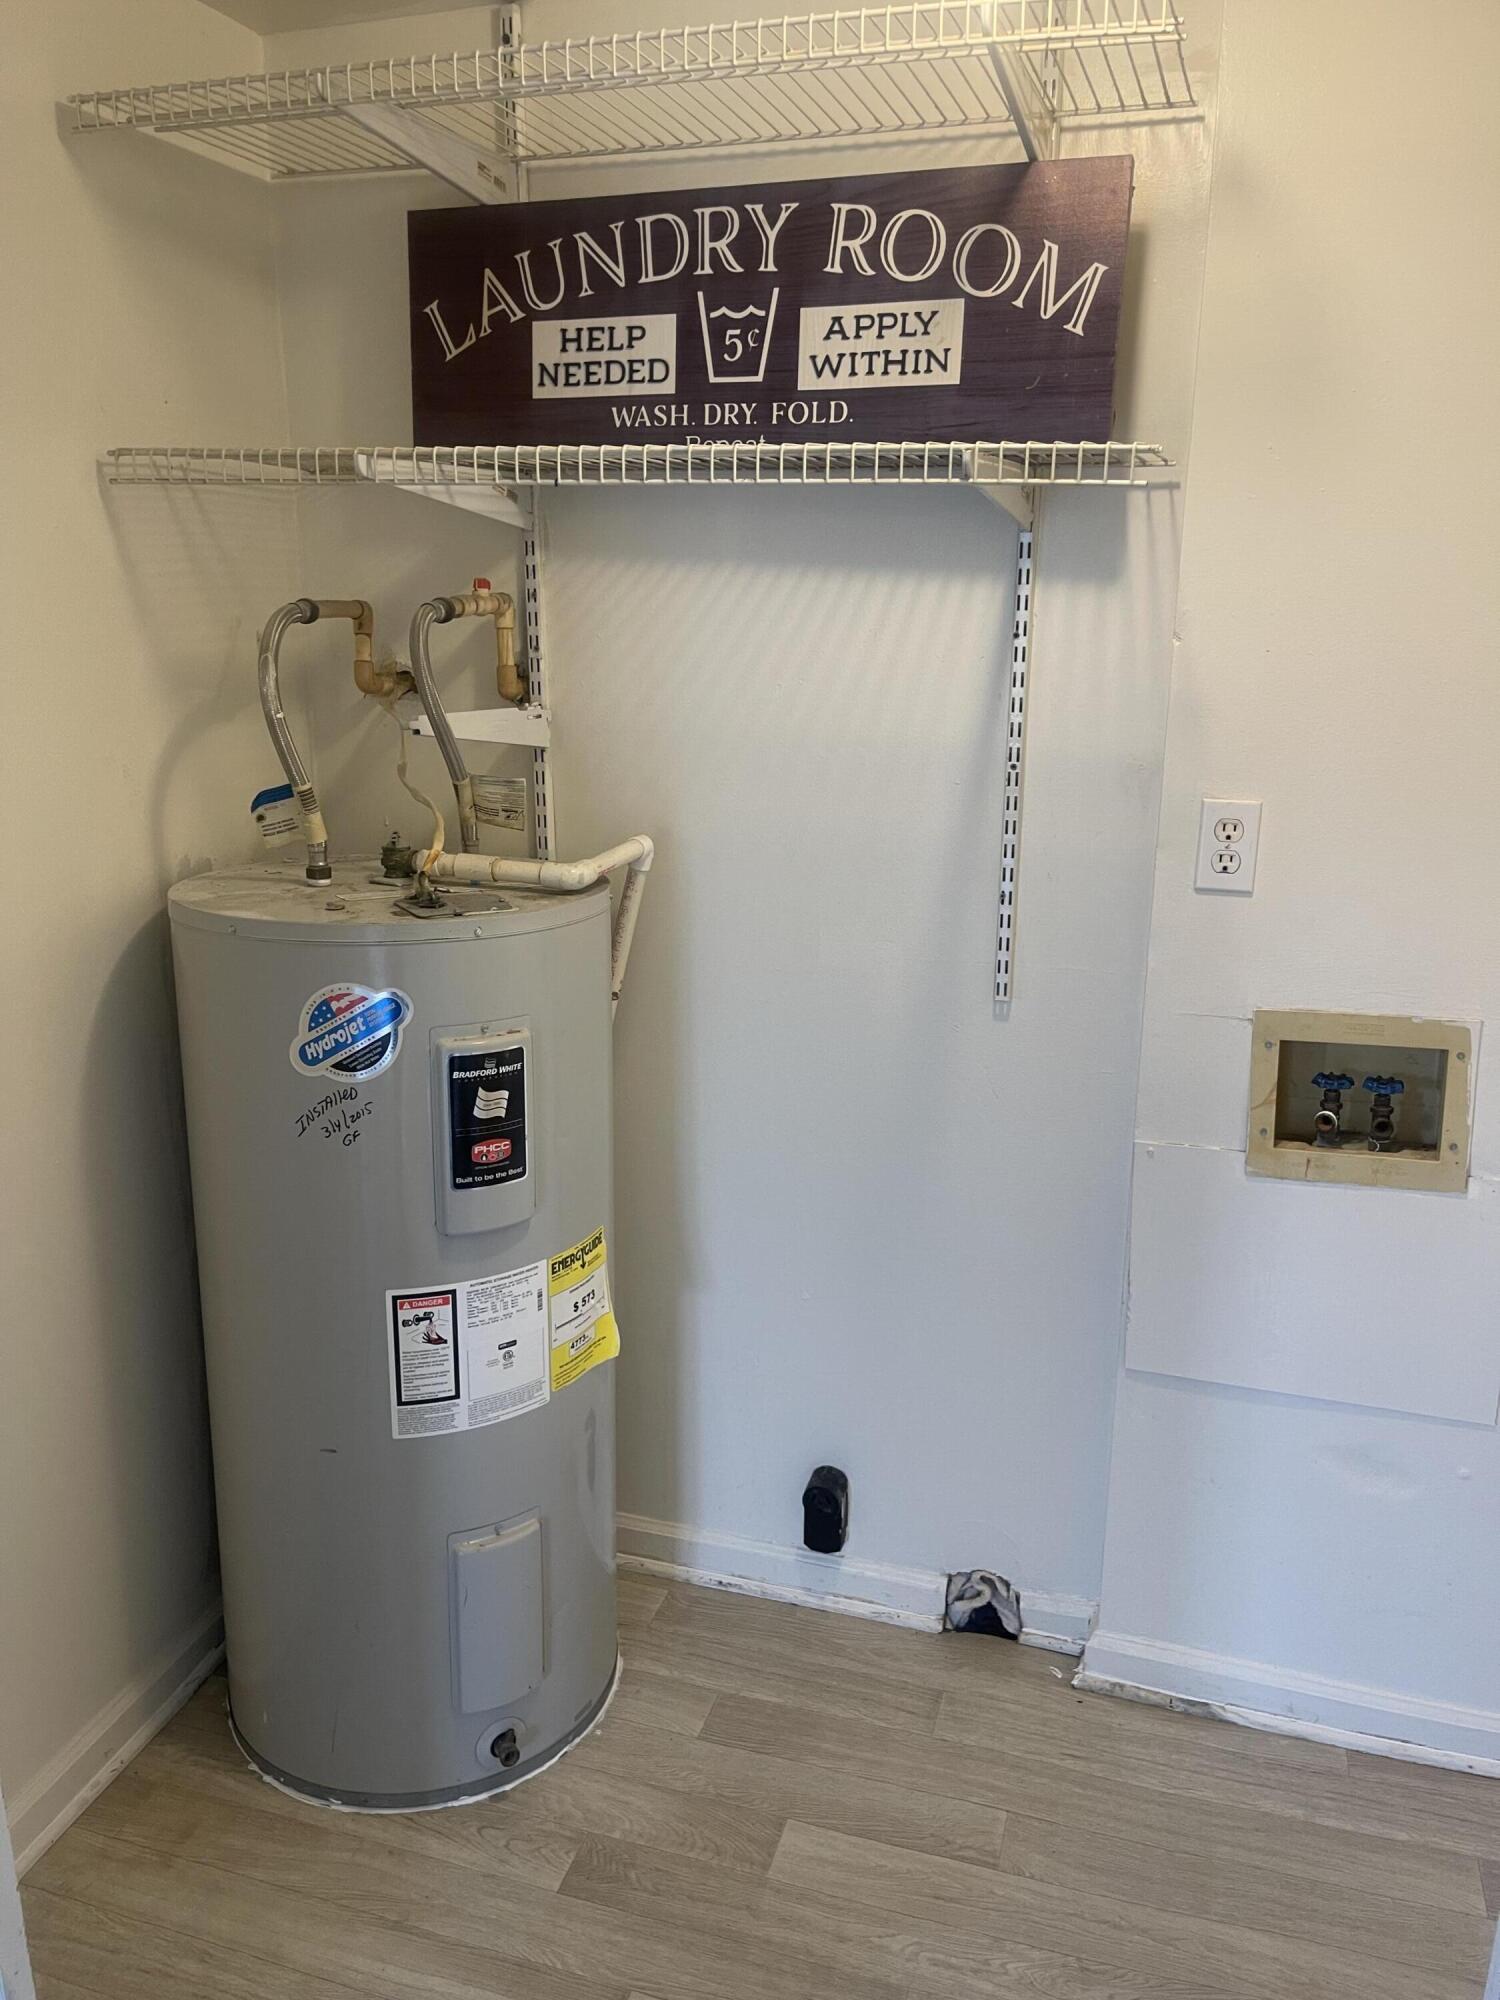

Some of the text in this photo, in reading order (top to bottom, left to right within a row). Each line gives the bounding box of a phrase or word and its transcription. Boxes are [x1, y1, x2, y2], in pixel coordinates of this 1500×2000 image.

[422, 202, 1109, 361] LAUNDRY ROOM
[559, 325, 647, 353] HELP
[822, 310, 940, 341] APPLY
[723, 328, 760, 362] 5¢
[537, 358, 670, 387] NEEDED
[808, 347, 953, 380] WITHIN
[611, 400, 854, 428] WASH. DRY. FOLD.
[304, 1016, 367, 1060] Hydrojet
[452, 1068, 498, 1079] BRADFORD
[498, 1062, 523, 1074] WHITE
[474, 1141, 511, 1154] PHCC
[484, 1173, 494, 1181] be
[495, 1171, 507, 1179] the
[508, 1166, 524, 1176] Best
[412, 1299, 443, 1308] DANGER
